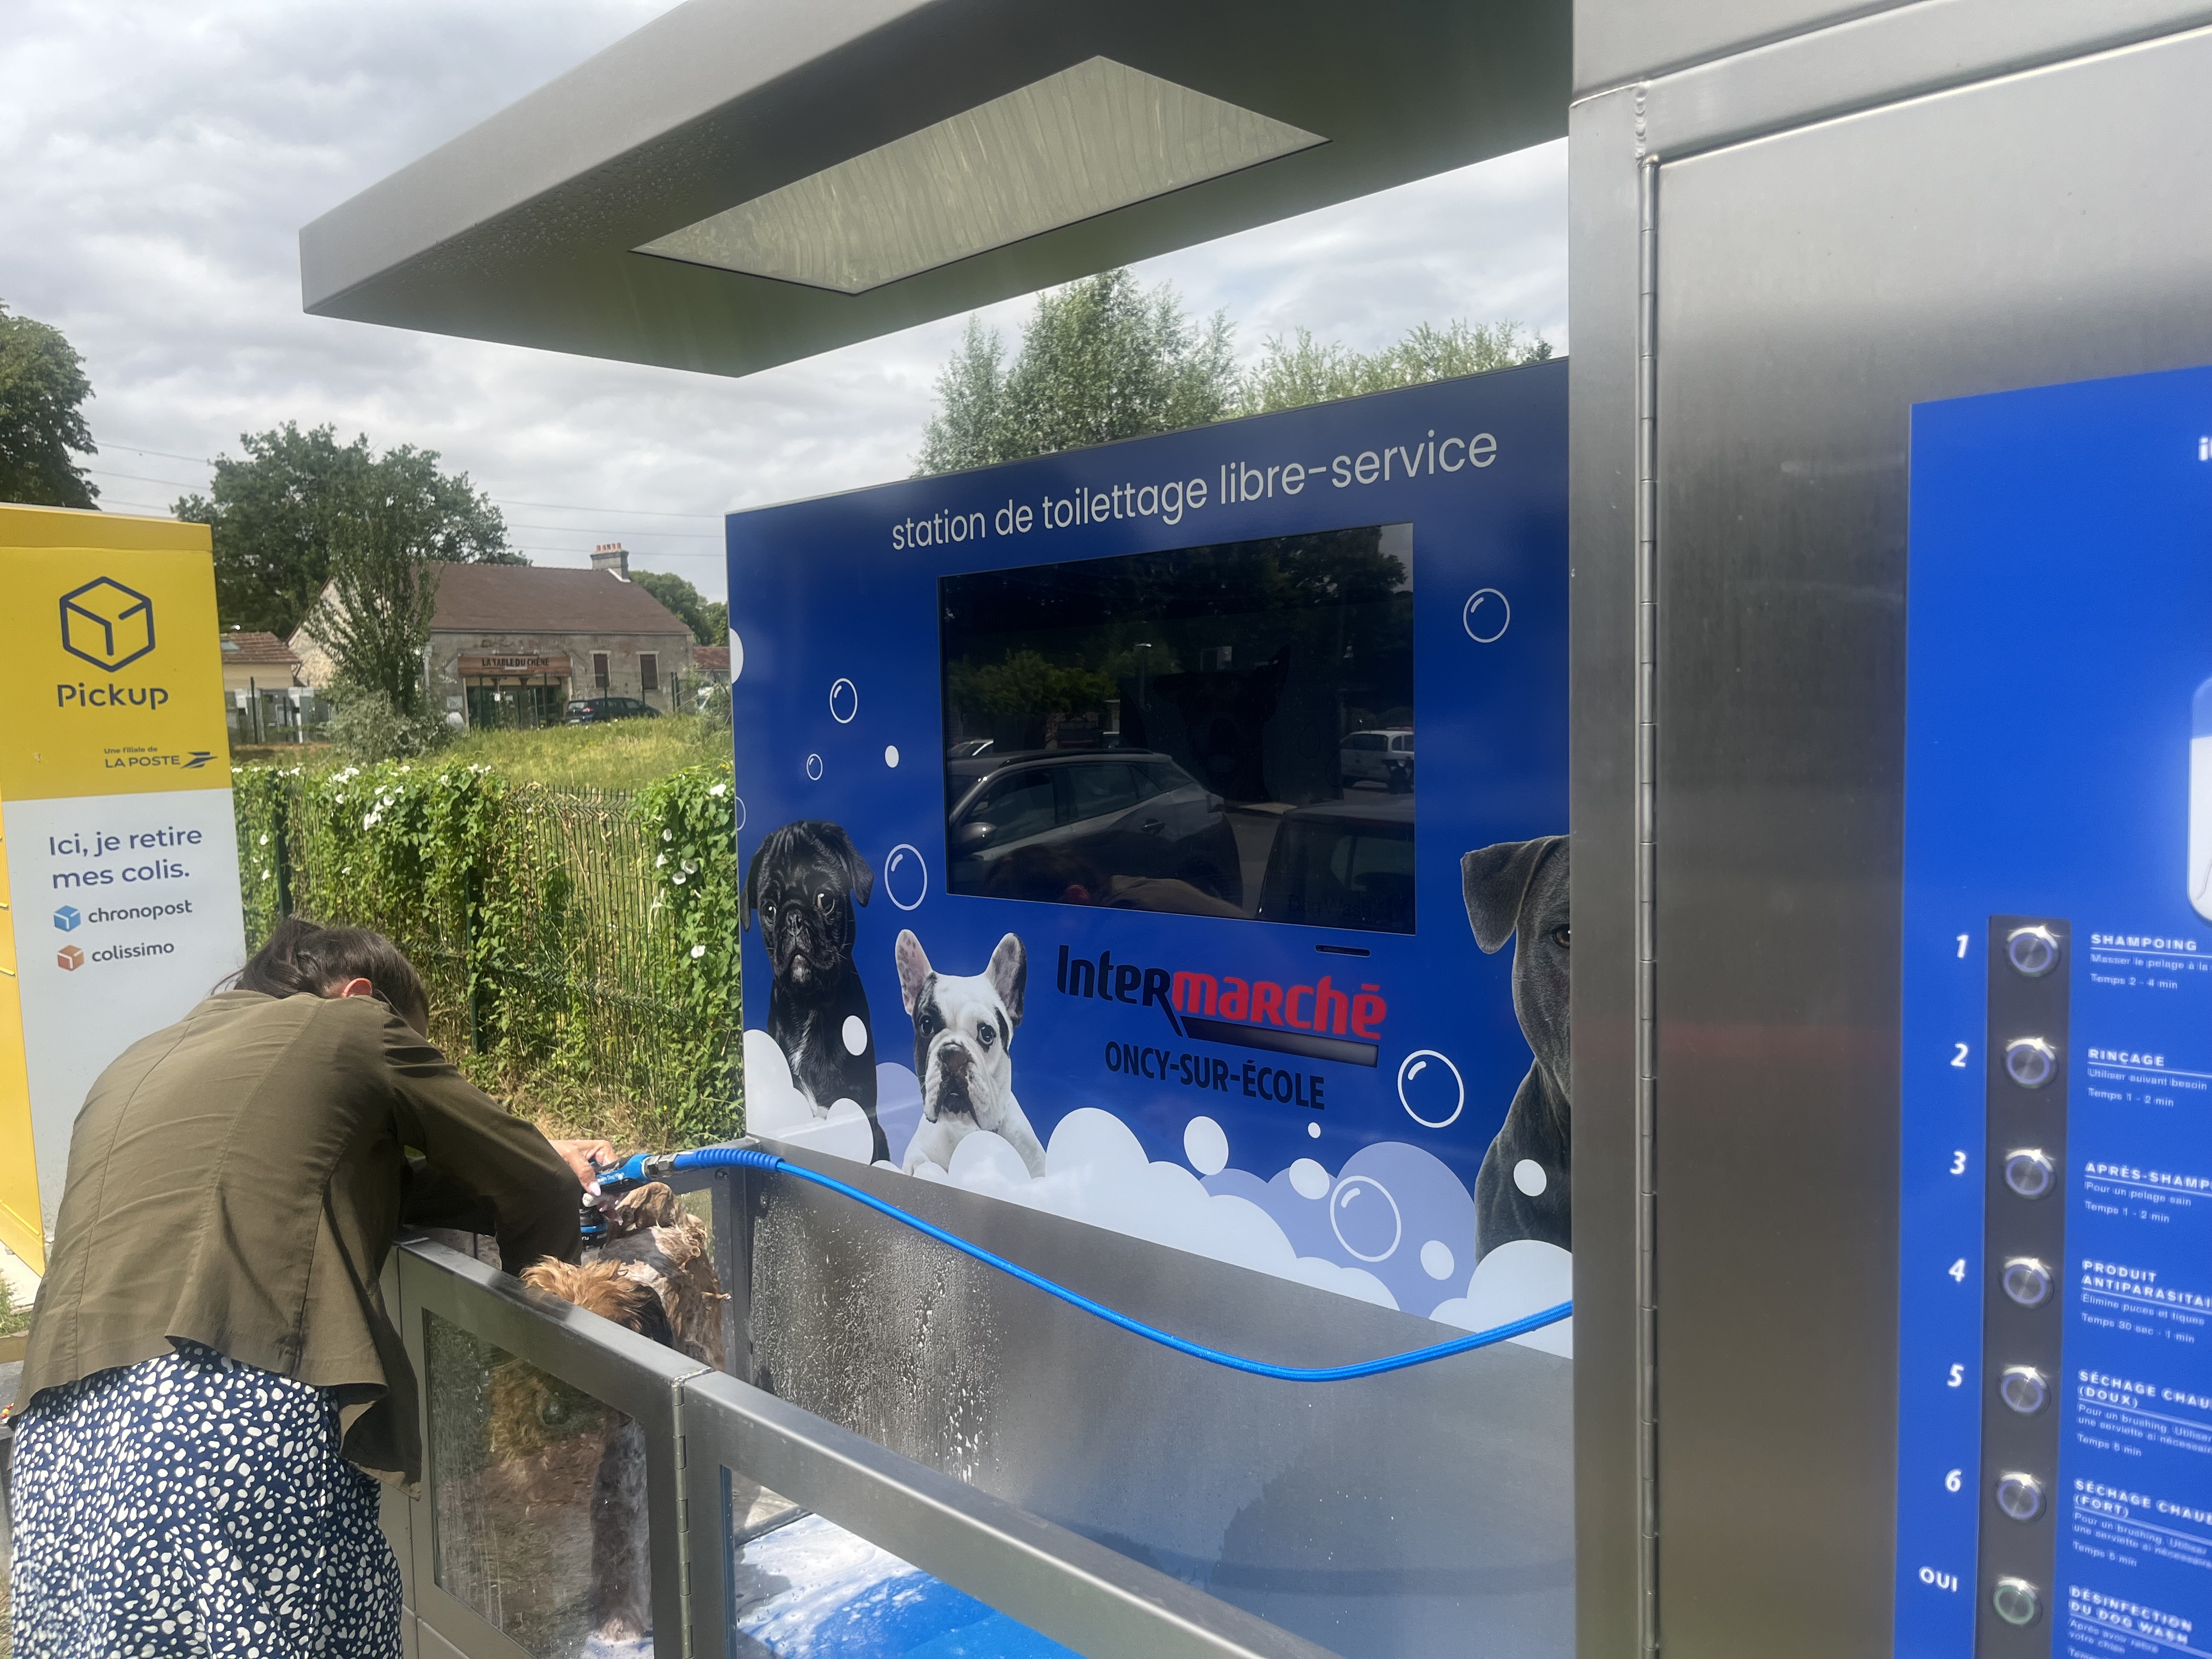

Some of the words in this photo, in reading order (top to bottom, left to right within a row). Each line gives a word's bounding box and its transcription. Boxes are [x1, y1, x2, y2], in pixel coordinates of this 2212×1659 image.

[893, 509, 986, 550] station
[995, 499, 1033, 535] de
[1042, 478, 1207, 525] toilettage
[1221, 430, 1497, 504] libre-service
[493, 658, 515, 667] TABLE
[516, 658, 526, 667] DU
[57, 682, 168, 710] Pickup
[105, 758, 126, 768] LA
[129, 755, 180, 767] POSTE
[50, 833, 88, 856] Ici,
[94, 832, 120, 856] je
[129, 826, 202, 849] retire
[53, 869, 114, 889] mes
[122, 859, 189, 882] colis.
[88, 900, 193, 922] chronopost
[92, 943, 174, 962] colissimo
[1956, 934, 1968, 958] 1
[2091, 934, 2197, 951] SHAMPOING
[2134, 957, 2143, 966] le
[2147, 959, 2184, 970] pelage
[2091, 974, 2125, 985] Temps
[2129, 977, 2136, 985] 2
[2148, 979, 2154, 987] 4
[2158, 980, 2177, 989] min
[1950, 1043, 1968, 1067] 2
[2088, 1048, 2164, 1066] RINÇAGE
[1105, 1041, 1325, 1110] ONCY-SUR-ÉCOLE
[2088, 1068, 2125, 1080] Utiliser
[2129, 1074, 2167, 1086] suivant
[2170, 1078, 2207, 1090] besoin
[2088, 1088, 2122, 1101] Temps
[2154, 1097, 2174, 1107] min
[1950, 1151, 1966, 1175] 3
[2086, 1162, 2212, 1190] APRÈS-SHAMP
[2085, 1182, 2109, 1193] Pour
[2129, 1190, 2165, 1203] pelage
[2169, 1196, 2191, 1206] sain
[2085, 1201, 2119, 1215] Temps
[2141, 1210, 2147, 1219] 2
[2150, 1212, 2169, 1223] min
[1948, 1258, 1966, 1282] 4
[2083, 1260, 2156, 1282] PRODUIT
[2083, 1275, 2212, 1308] ANTIPARASITAI
[2121, 1304, 2154, 1316] puces
[2171, 1312, 2204, 1325] tiques
[2082, 1312, 2114, 1328] Temps
[2174, 1332, 2194, 1343] min
[1947, 1364, 1964, 1387] 5
[2078, 1386, 2138, 1408] (DOUX)
[2079, 1370, 2155, 1397] SÉCHAGE
[2162, 1389, 2212, 1409] CHAU
[2078, 1404, 2102, 1416] Pour
[2105, 1412, 2118, 1420] un
[2078, 1433, 2109, 1448] Temps
[2122, 1445, 2142, 1457] min
[1945, 1469, 1962, 1492] 6
[2073, 1494, 2129, 1517] (FORT)
[2074, 1480, 2151, 1508] SÉCHAGE
[2073, 1512, 2097, 1525] Pour
[2101, 1521, 2112, 1530] un
[2119, 1555, 2137, 1567] min
[1920, 1567, 1957, 1592] OUI
[2069, 1599, 2091, 1616] DU
[2069, 1585, 2192, 1633] DÉSINFECTION
